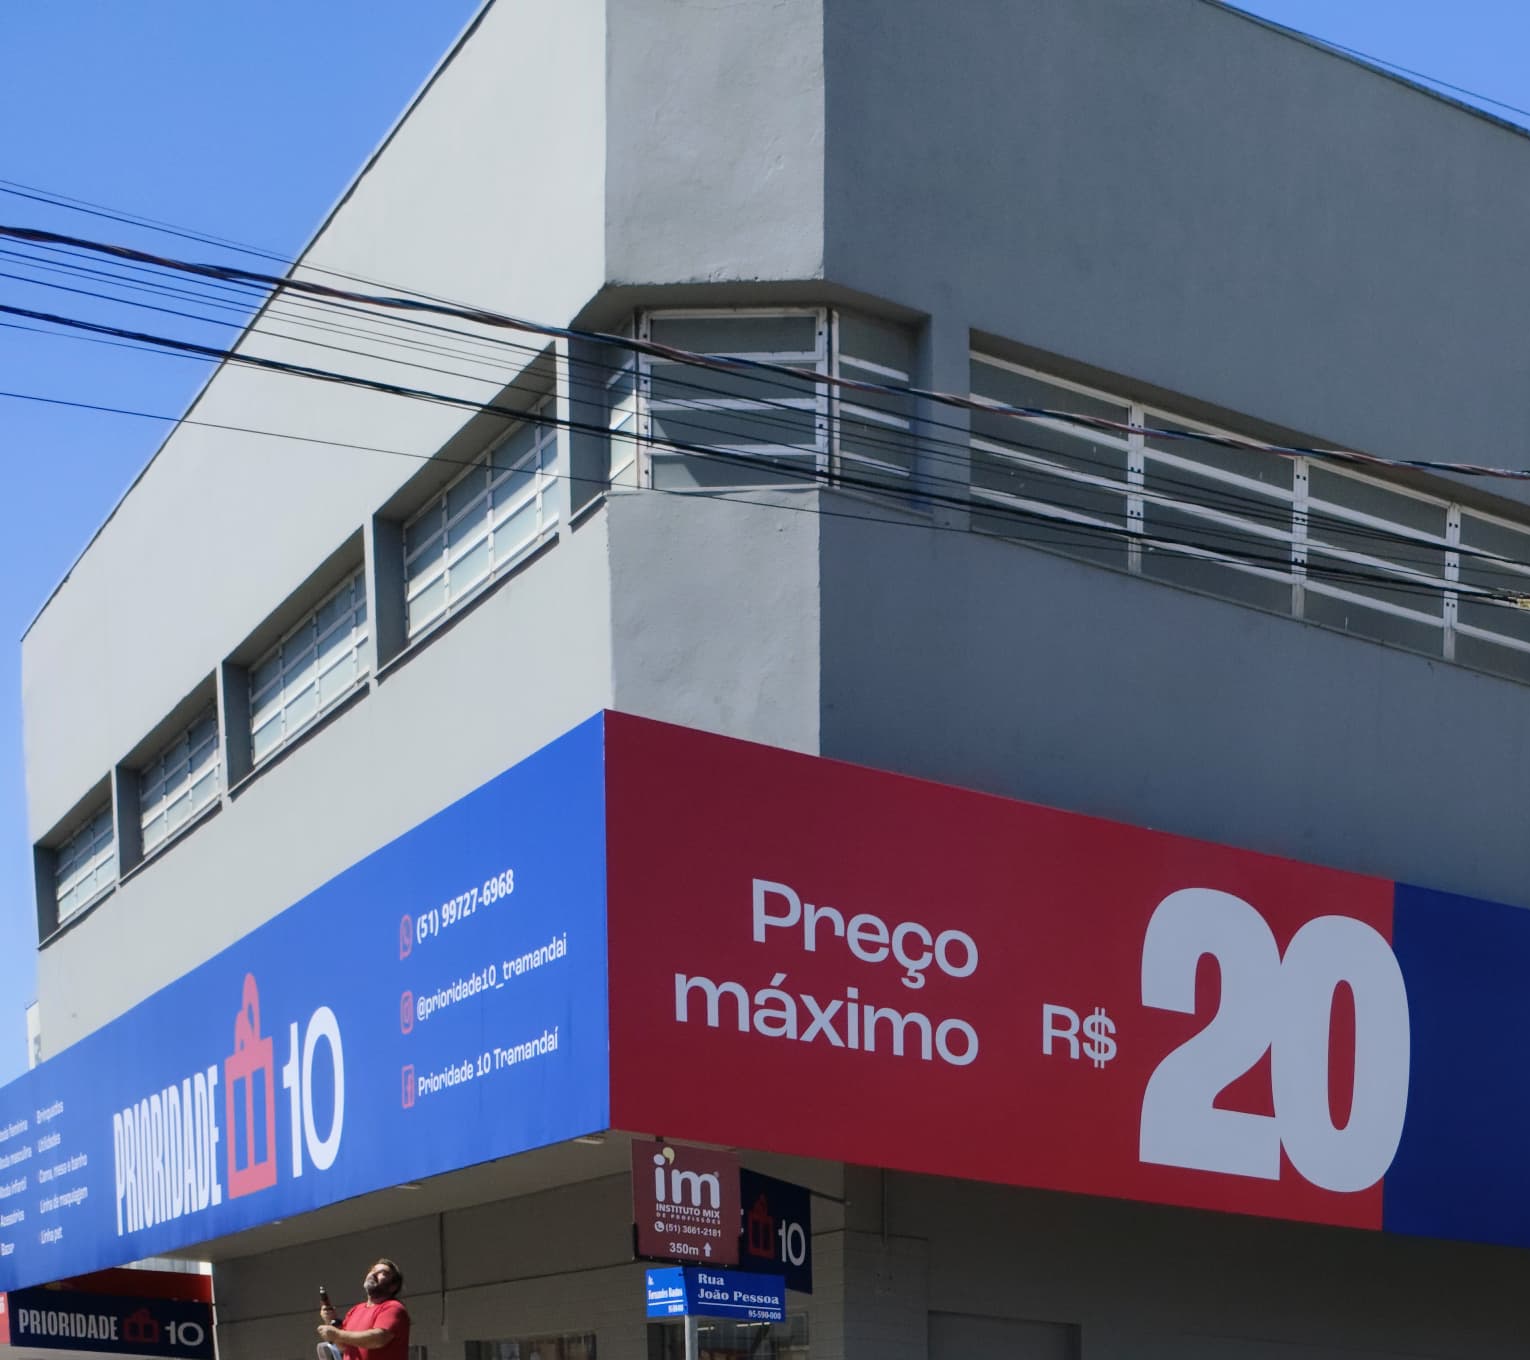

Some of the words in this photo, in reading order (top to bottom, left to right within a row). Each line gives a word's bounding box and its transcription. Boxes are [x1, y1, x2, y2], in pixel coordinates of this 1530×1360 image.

[416, 909, 439, 944] (51)
[441, 868, 515, 928] 99727-6968
[751, 877, 979, 989] Preço
[416, 932, 568, 1022] @prioridade10_tramandai
[673, 972, 979, 1067] máximo
[1041, 1004, 1118, 1070] R$
[1139, 886, 1411, 1193] 20
[418, 1060, 474, 1097] Prioridade
[476, 1052, 491, 1077] 10
[494, 1026, 559, 1071] Tramandaí
[113, 1064, 222, 1237] PRIORIDADE
[282, 1005, 345, 1179] 10
[656, 1202, 701, 1217] INSTITUTO
[703, 1207, 720, 1219] MIX
[665, 1224, 681, 1234] (51)
[778, 1219, 806, 1267] 10
[669, 1242, 699, 1257] 350m
[698, 1273, 724, 1286] Rua
[18, 1308, 119, 1341] PRIORIDADE
[164, 1320, 205, 1346] 10
[698, 1288, 729, 1301] João
[733, 1290, 780, 1305] Pessoa
